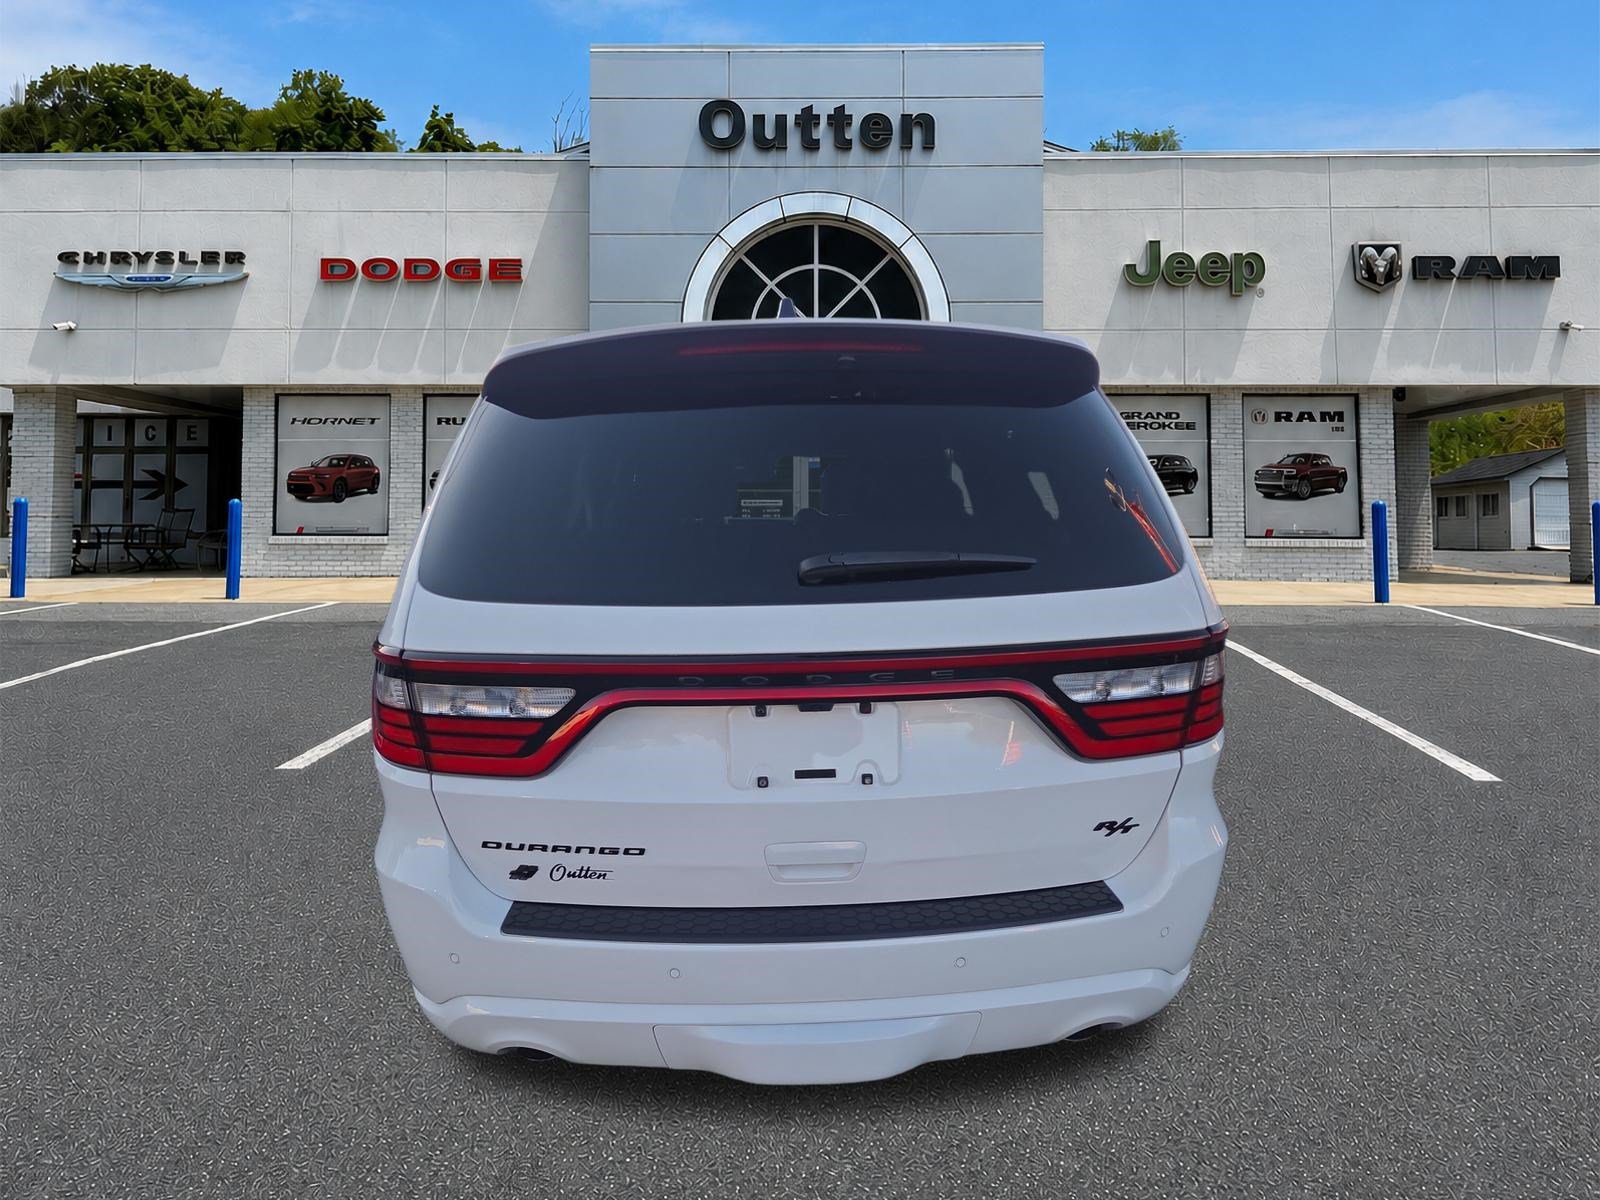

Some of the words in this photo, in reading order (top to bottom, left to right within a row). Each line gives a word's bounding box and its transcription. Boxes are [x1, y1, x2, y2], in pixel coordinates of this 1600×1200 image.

[699, 99, 936, 150] Outten
[57, 250, 247, 266] CHRYSLER
[320, 257, 523, 282] DODGE
[1123, 240, 1266, 296] Jeep
[1411, 255, 1561, 280] RAM
[290, 417, 381, 426] HORNET
[1120, 411, 1181, 420] GRAND
[1273, 410, 1345, 423] RAM
[1125, 421, 1197, 431] EROKEE
[678, 670, 954, 686] DODGE
[1092, 816, 1140, 837] R/T
[481, 841, 646, 856] DURANGO
[549, 863, 614, 882] Outten
